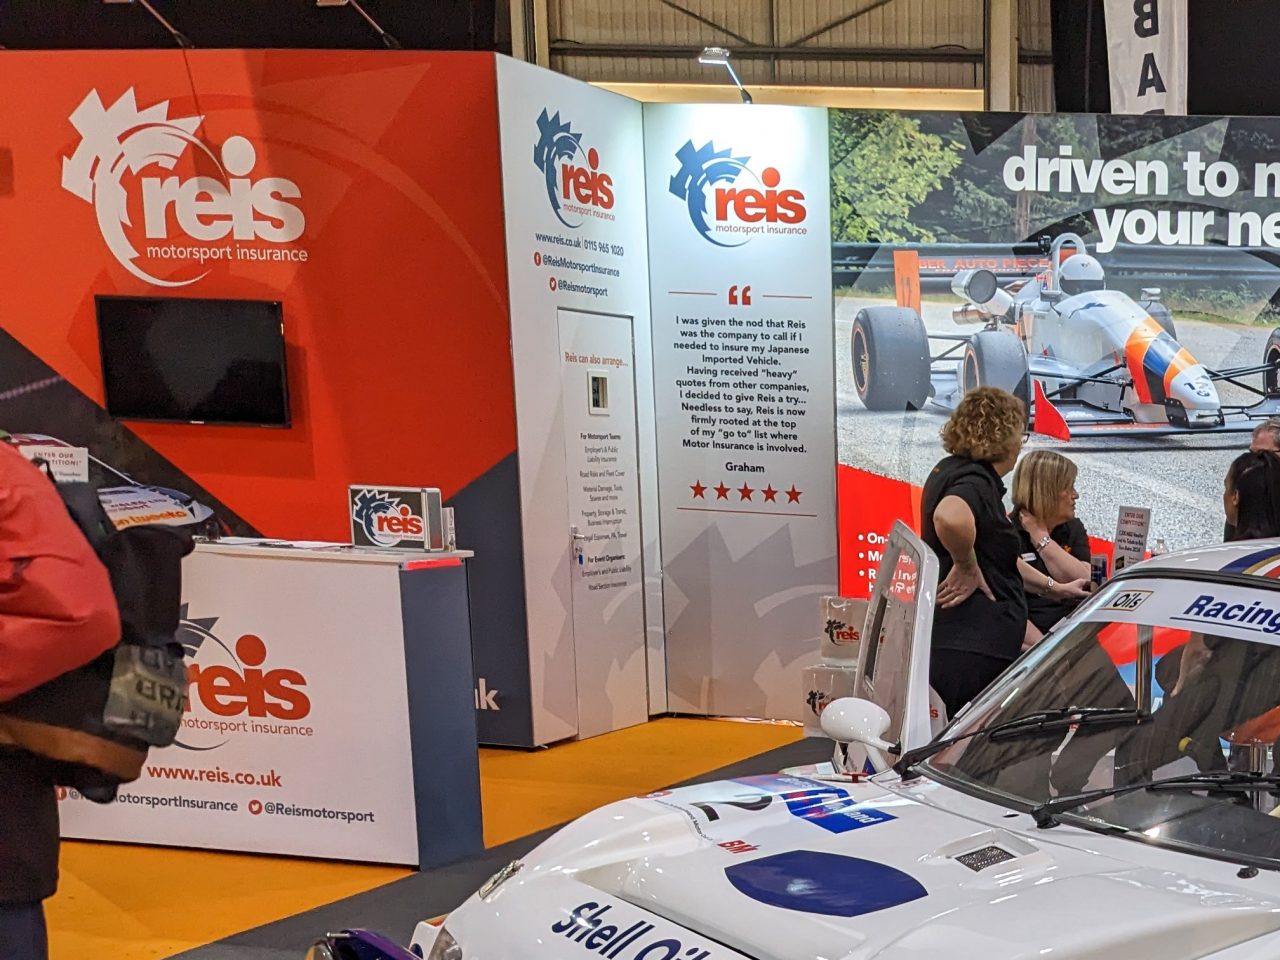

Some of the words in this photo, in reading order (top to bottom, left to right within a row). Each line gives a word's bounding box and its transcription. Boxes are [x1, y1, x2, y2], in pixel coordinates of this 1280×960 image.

[562, 148, 614, 209] reis
[1003, 145, 1168, 195] driven
[1183, 151, 1239, 197] to
[141, 135, 305, 241] reis
[715, 167, 807, 224] reis
[563, 204, 592, 216] motorsport
[593, 210, 615, 221] insurance
[716, 225, 764, 236] motorsport
[767, 225, 807, 235] insurance
[1093, 206, 1214, 253] your
[146, 243, 232, 264] motorsport
[236, 244, 308, 262] insurance
[584, 240, 597, 251] 0115
[598, 242, 609, 254] 965
[611, 244, 624, 256] 1020
[955, 259, 998, 269] AUTO
[558, 280, 608, 296] @Reismotorsport
[565, 352, 577, 363] Reis
[579, 355, 588, 364] can
[702, 355, 743, 365] Imported
[746, 356, 781, 365] Vehicle.
[676, 379, 706, 388] quotes
[709, 380, 730, 388] from
[733, 380, 757, 389] other
[760, 382, 810, 392] companies,
[683, 440, 709, 448] Motor
[713, 441, 754, 450] Insurance
[757, 442, 764, 451] is
[767, 443, 807, 453] involved.
[725, 462, 765, 473] Graham
[377, 506, 422, 534] reis
[1114, 593, 1142, 608] Oils
[836, 626, 859, 640] reis
[252, 720, 313, 737] insurance
[147, 764, 282, 787] www.reis.co.uk
[265, 801, 375, 823] @Reismotorsport
[552, 901, 646, 959] Shell
